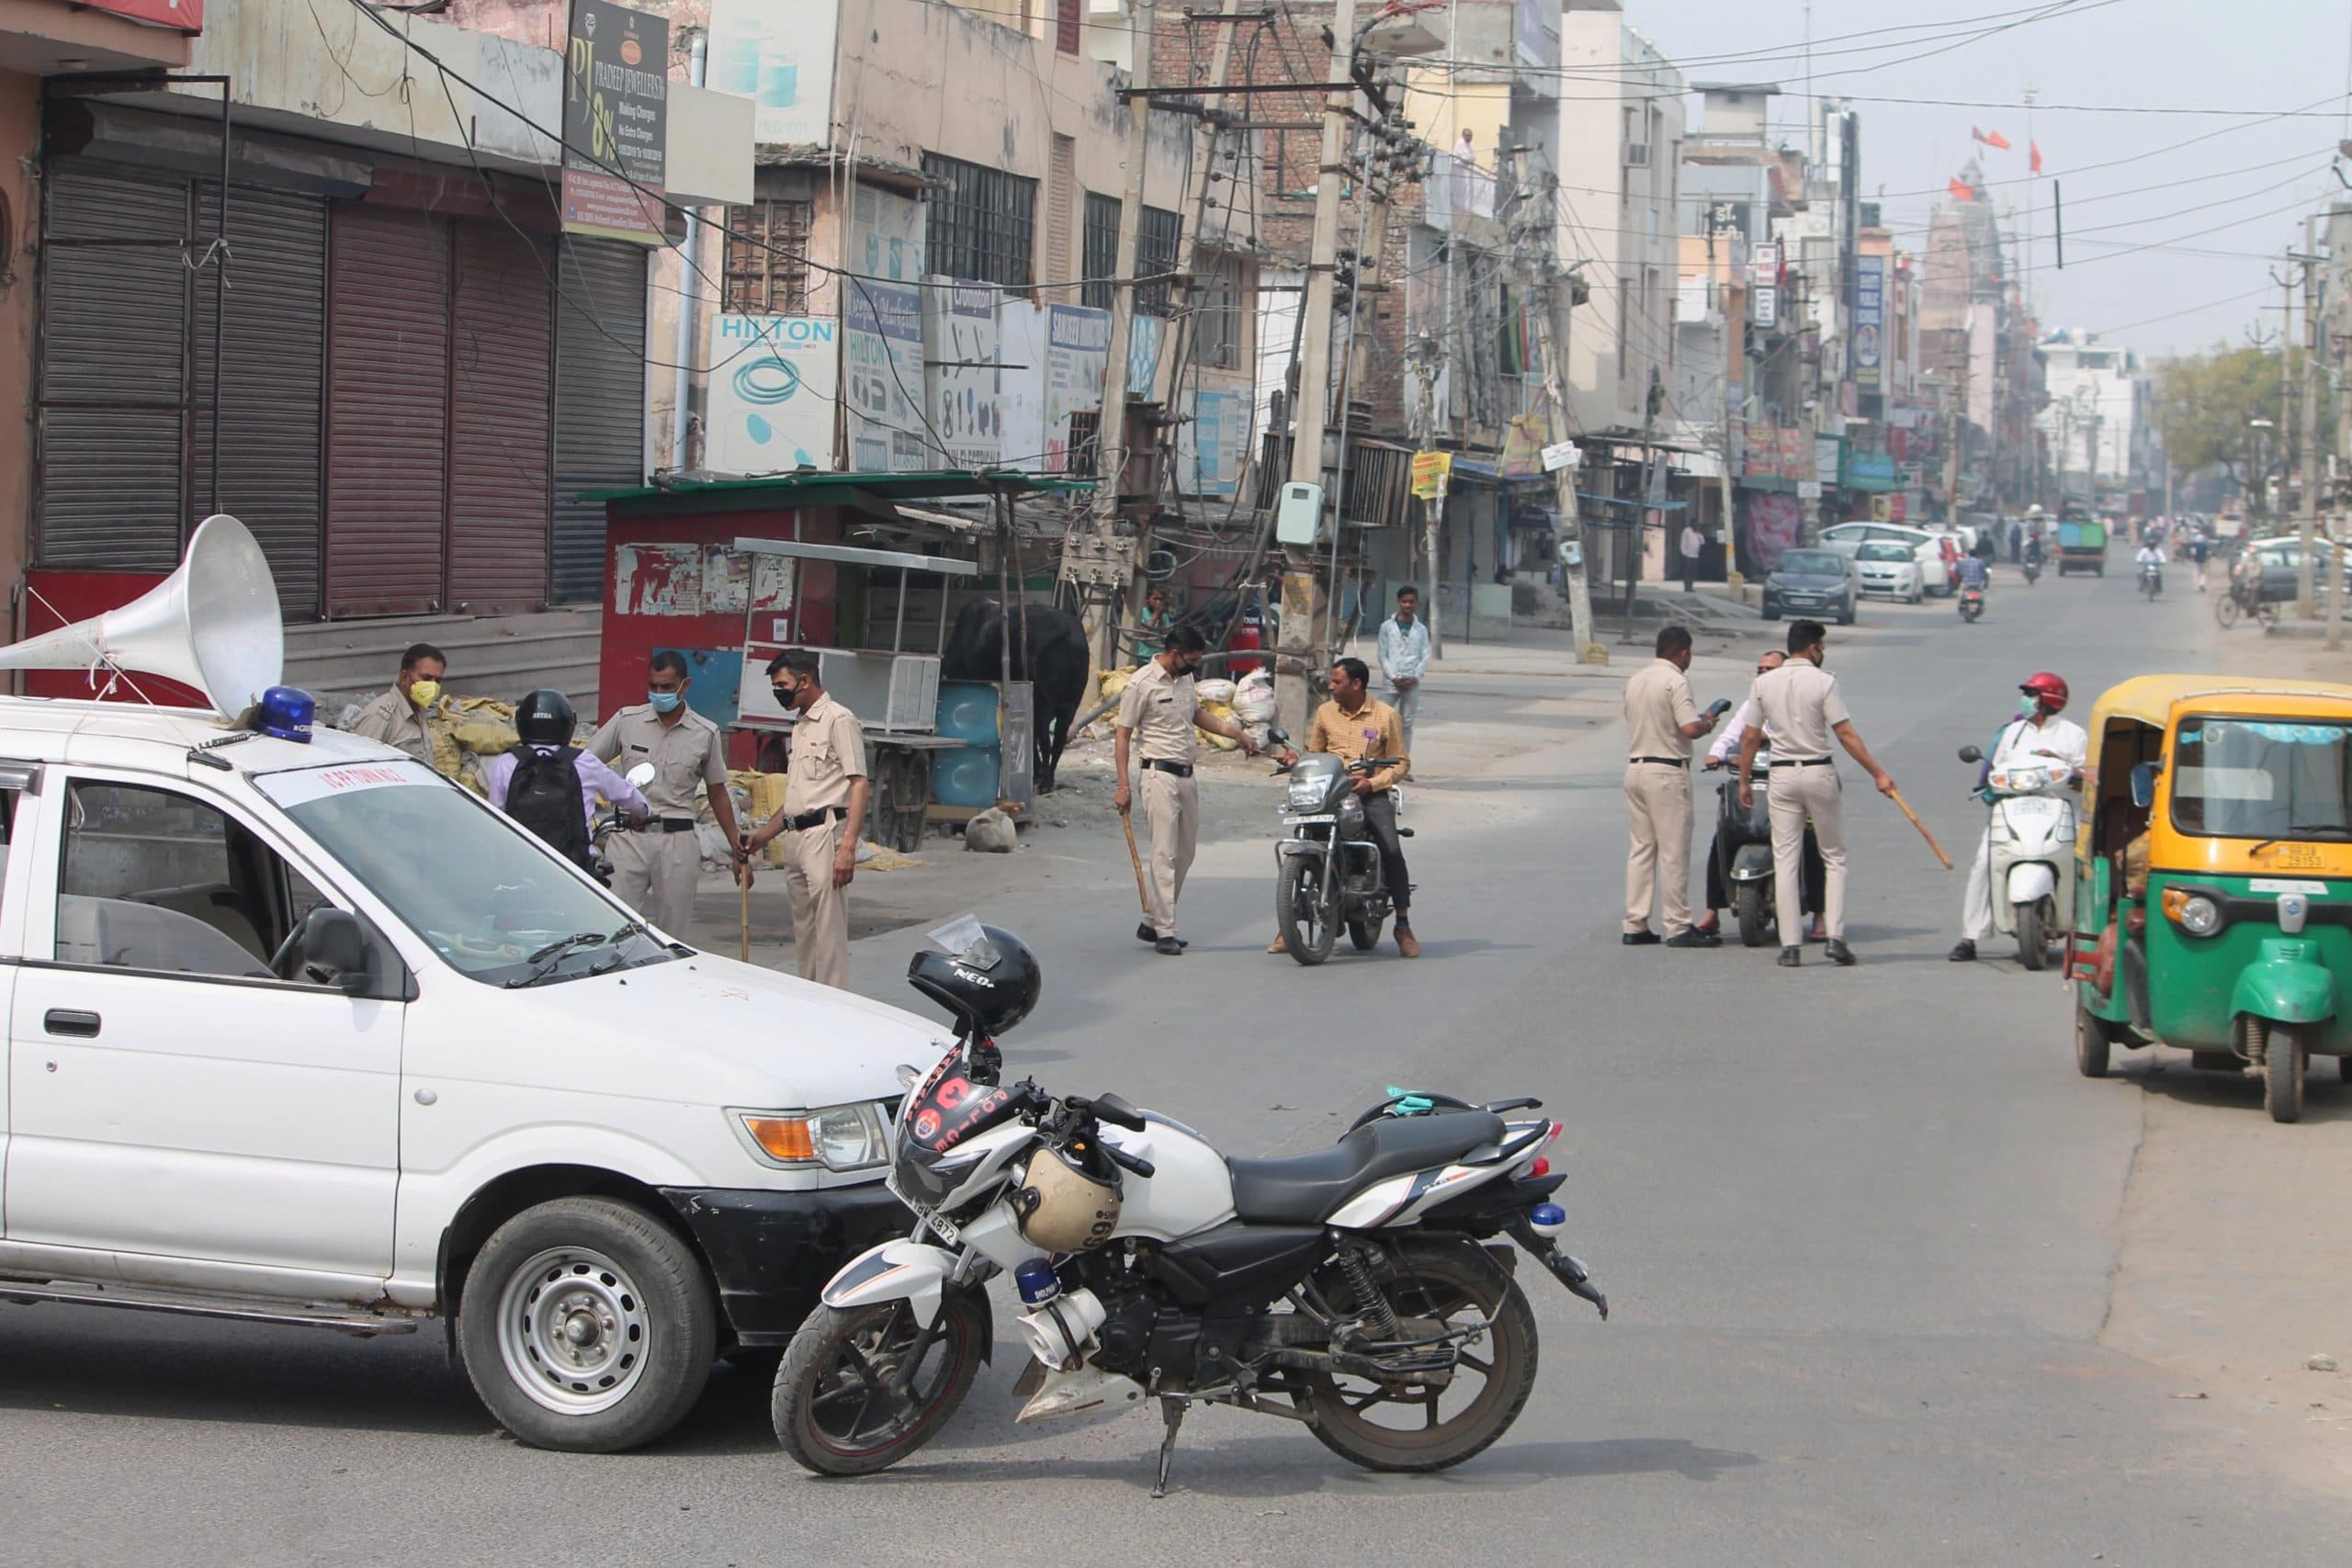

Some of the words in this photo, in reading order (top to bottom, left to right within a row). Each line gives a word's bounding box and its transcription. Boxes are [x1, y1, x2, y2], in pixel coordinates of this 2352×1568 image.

[570, 36, 594, 125] PJ
[594, 61, 625, 92] PRADEEP
[592, 92, 616, 162] 8%
[954, 281, 990, 314] Crompton
[721, 317, 832, 342] HILTON
[849, 331, 887, 366] HILTON
[933, 1089, 1009, 1153] POLICE
